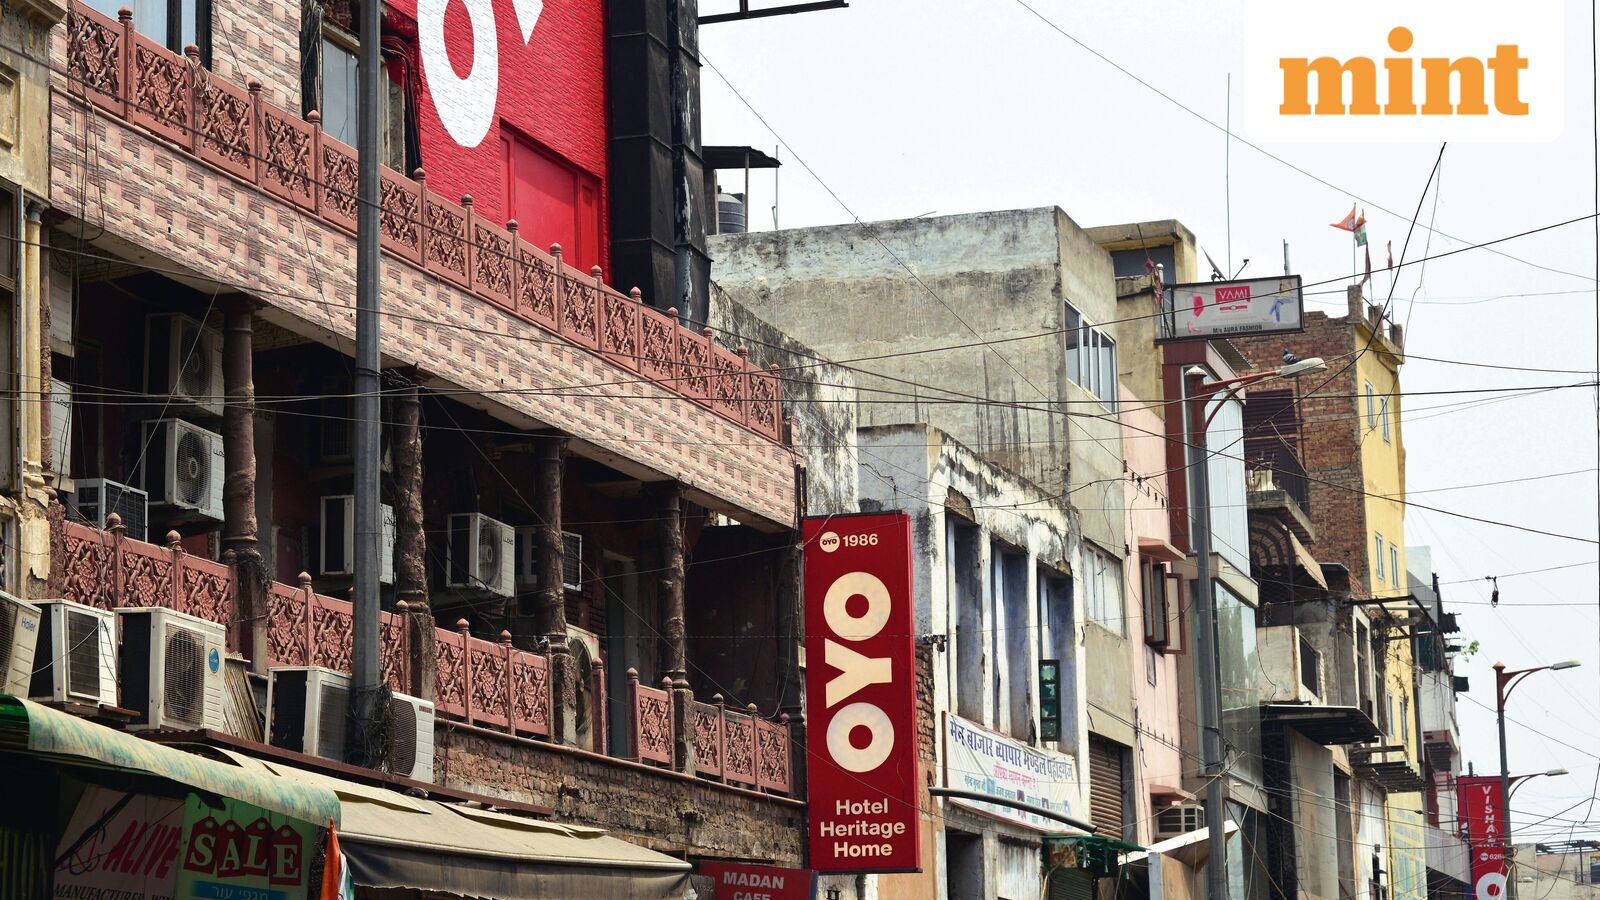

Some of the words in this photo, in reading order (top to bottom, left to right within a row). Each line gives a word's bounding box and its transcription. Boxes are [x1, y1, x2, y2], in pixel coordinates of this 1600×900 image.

[1219, 288, 1249, 299] VAMI
[1239, 324, 1263, 332] FASHION
[821, 538, 838, 546] OYO
[842, 533, 879, 547] 1986
[21, 616, 36, 633] Haier
[823, 571, 895, 773] OYO
[951, 721, 965, 746] मेन
[967, 730, 994, 757] बाजार
[996, 741, 1021, 767] व्यापार
[836, 798, 888, 816] Hotel
[1482, 785, 1497, 843] VISHAL
[820, 820, 906, 840] Heritage
[190, 834, 299, 879] SALE
[834, 841, 893, 858] Home
[722, 871, 785, 890] MADAN
